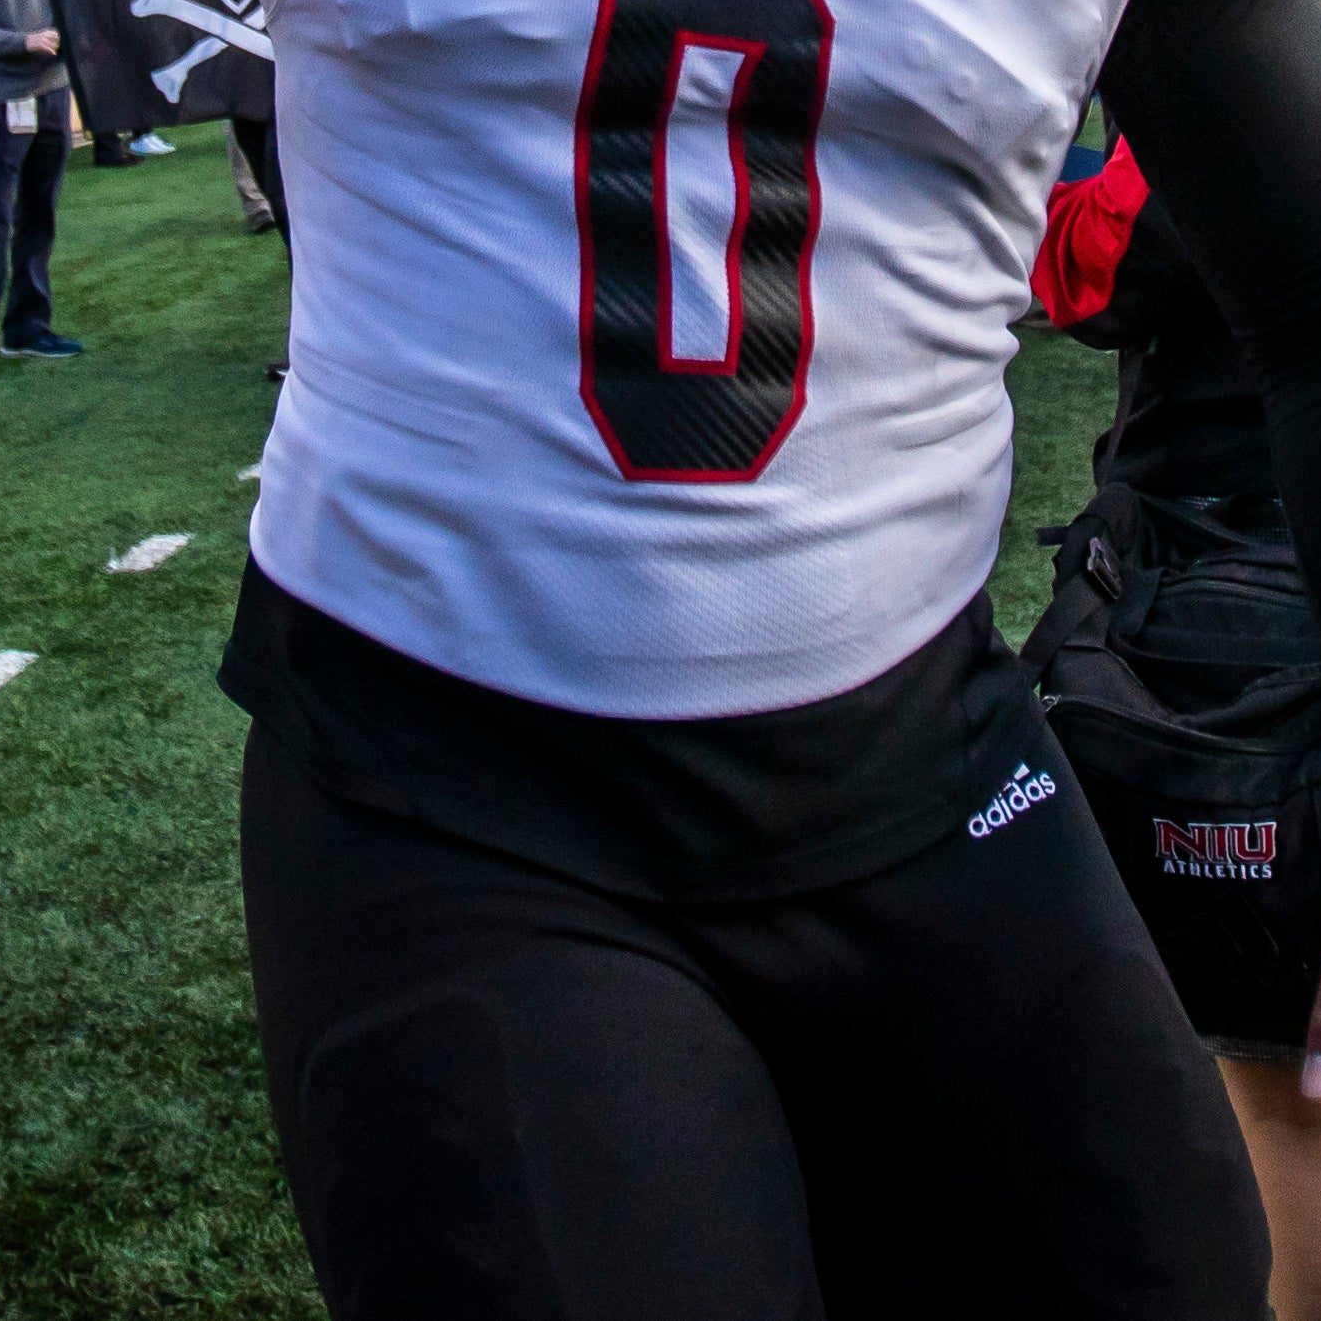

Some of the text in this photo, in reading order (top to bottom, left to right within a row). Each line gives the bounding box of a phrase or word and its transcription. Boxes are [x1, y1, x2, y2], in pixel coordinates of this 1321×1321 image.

[968, 773, 1056, 839] adidas
[1152, 817, 1277, 865] NIU
[1163, 859, 1273, 879] ATHLETICS
